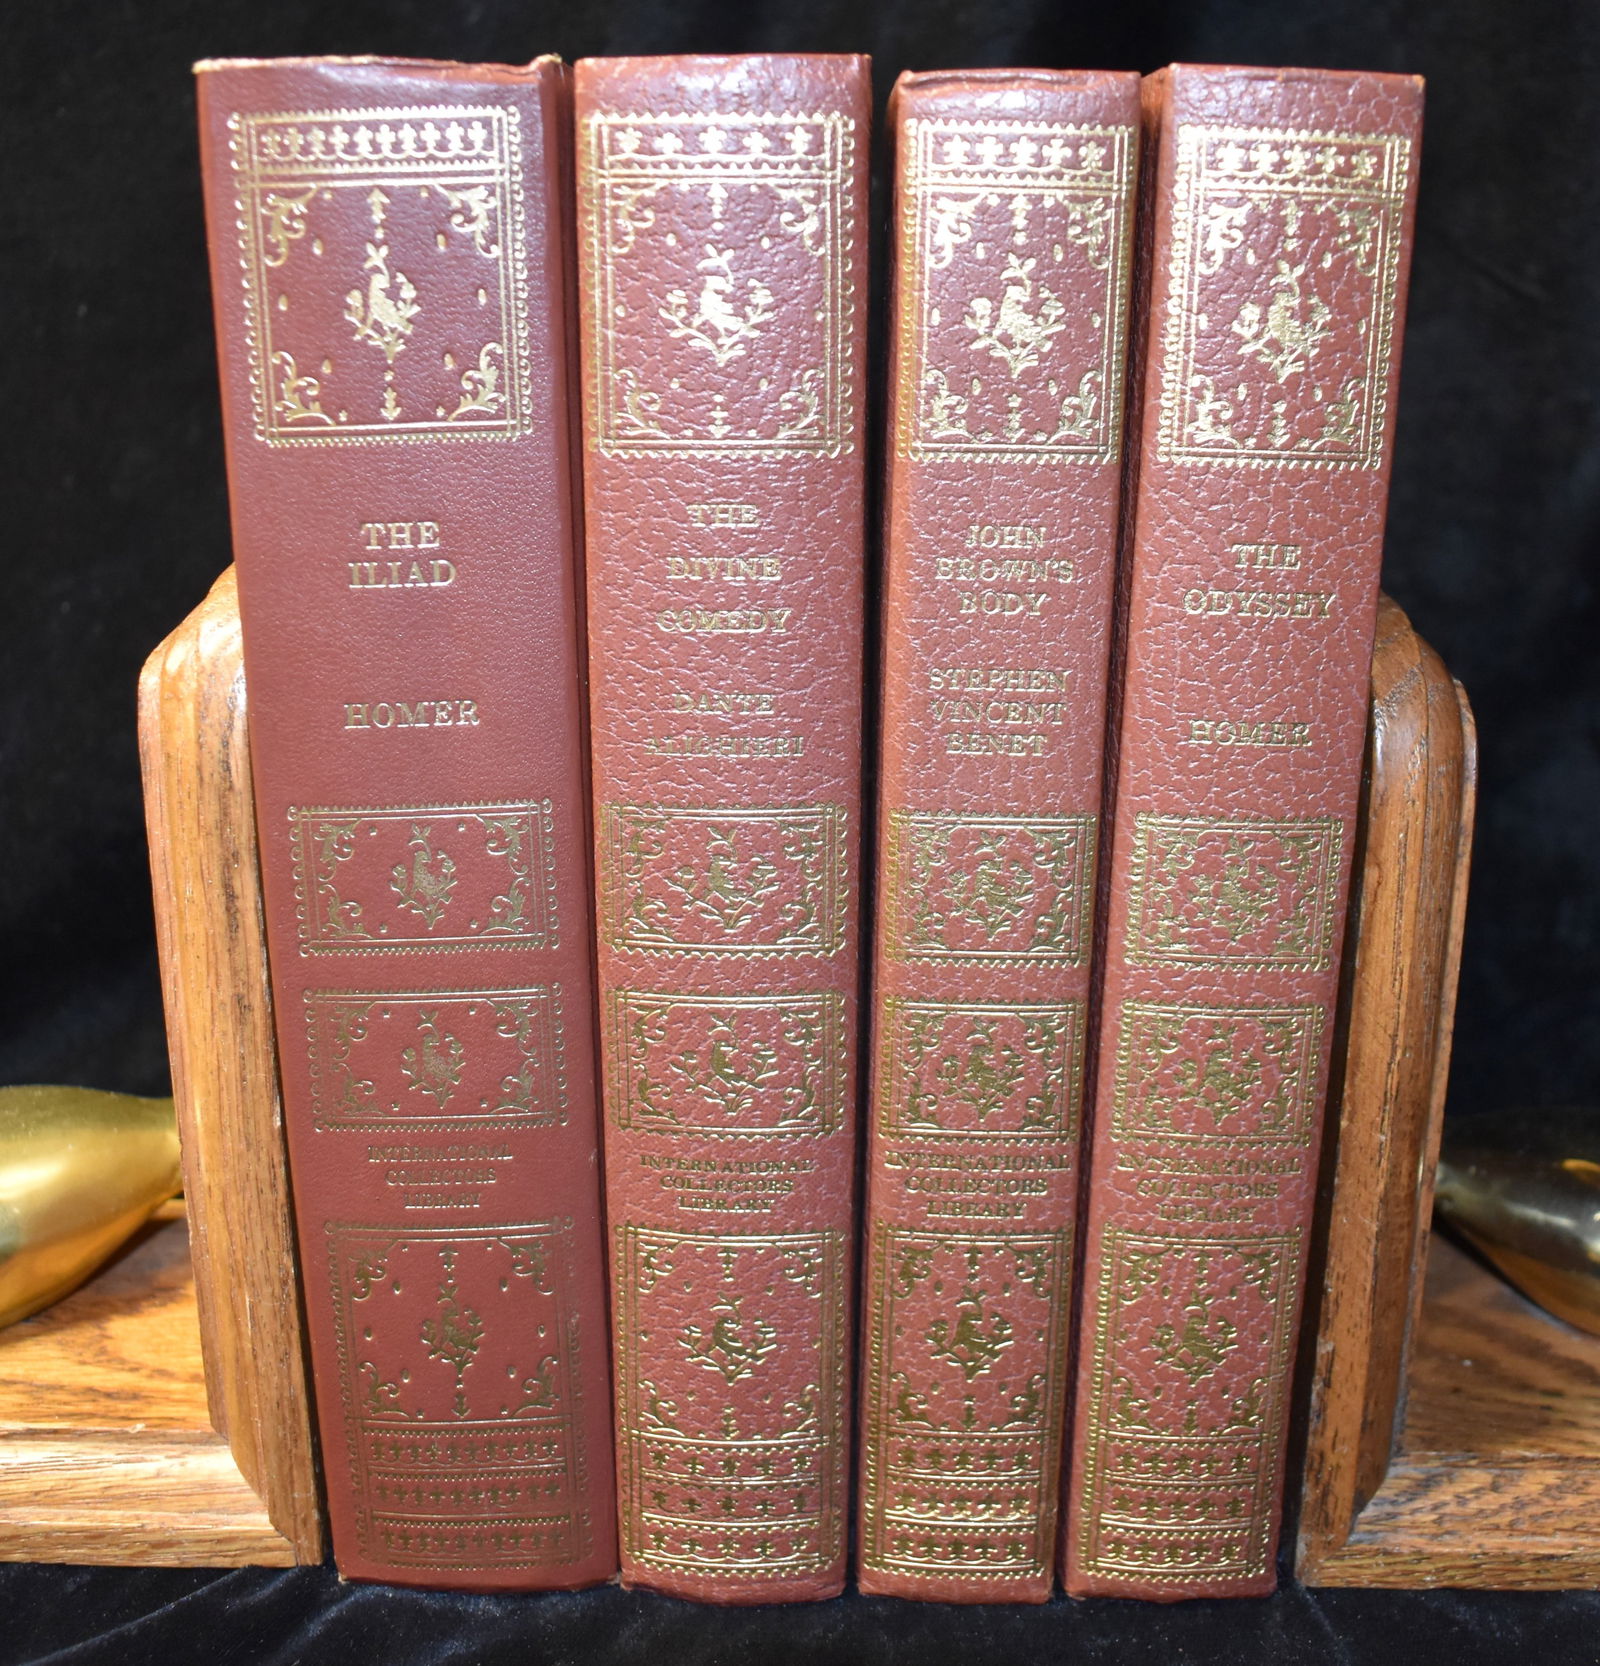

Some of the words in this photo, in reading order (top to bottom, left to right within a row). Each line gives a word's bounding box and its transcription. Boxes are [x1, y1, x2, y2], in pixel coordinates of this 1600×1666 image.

[686, 504, 760, 527] THE
[360, 521, 440, 550] THE
[964, 525, 1047, 549] JOHN
[666, 556, 782, 580] DIVINE
[1230, 543, 1301, 570] THE
[348, 559, 456, 588] ILIAD
[935, 557, 1074, 583] BROWN'S
[960, 591, 1048, 616] BODY
[1183, 588, 1337, 618] ODYSSEY
[655, 609, 793, 632] COMEDY
[929, 668, 1073, 692] STEPHEN
[344, 700, 480, 729] HOMER
[672, 693, 775, 714] DANTE
[930, 701, 1068, 725] VINCENT
[1188, 719, 1313, 746] HOMER
[643, 736, 804, 758] ALIGHIERI
[946, 733, 1048, 757] BENET
[639, 1155, 818, 1175] INTERNATIONAL
[884, 1151, 1072, 1172] INTERNATIONAL
[1116, 1153, 1302, 1176] INTERNATIONAL
[659, 1176, 794, 1194] COLLECTORS
[904, 1176, 1048, 1195] COLLECTORS
[1136, 1179, 1278, 1199] COLLECTORS
[677, 1196, 774, 1213] LIBRARY
[926, 1201, 1027, 1219] LIBRARY
[1156, 1203, 1257, 1223] LIBRARY
